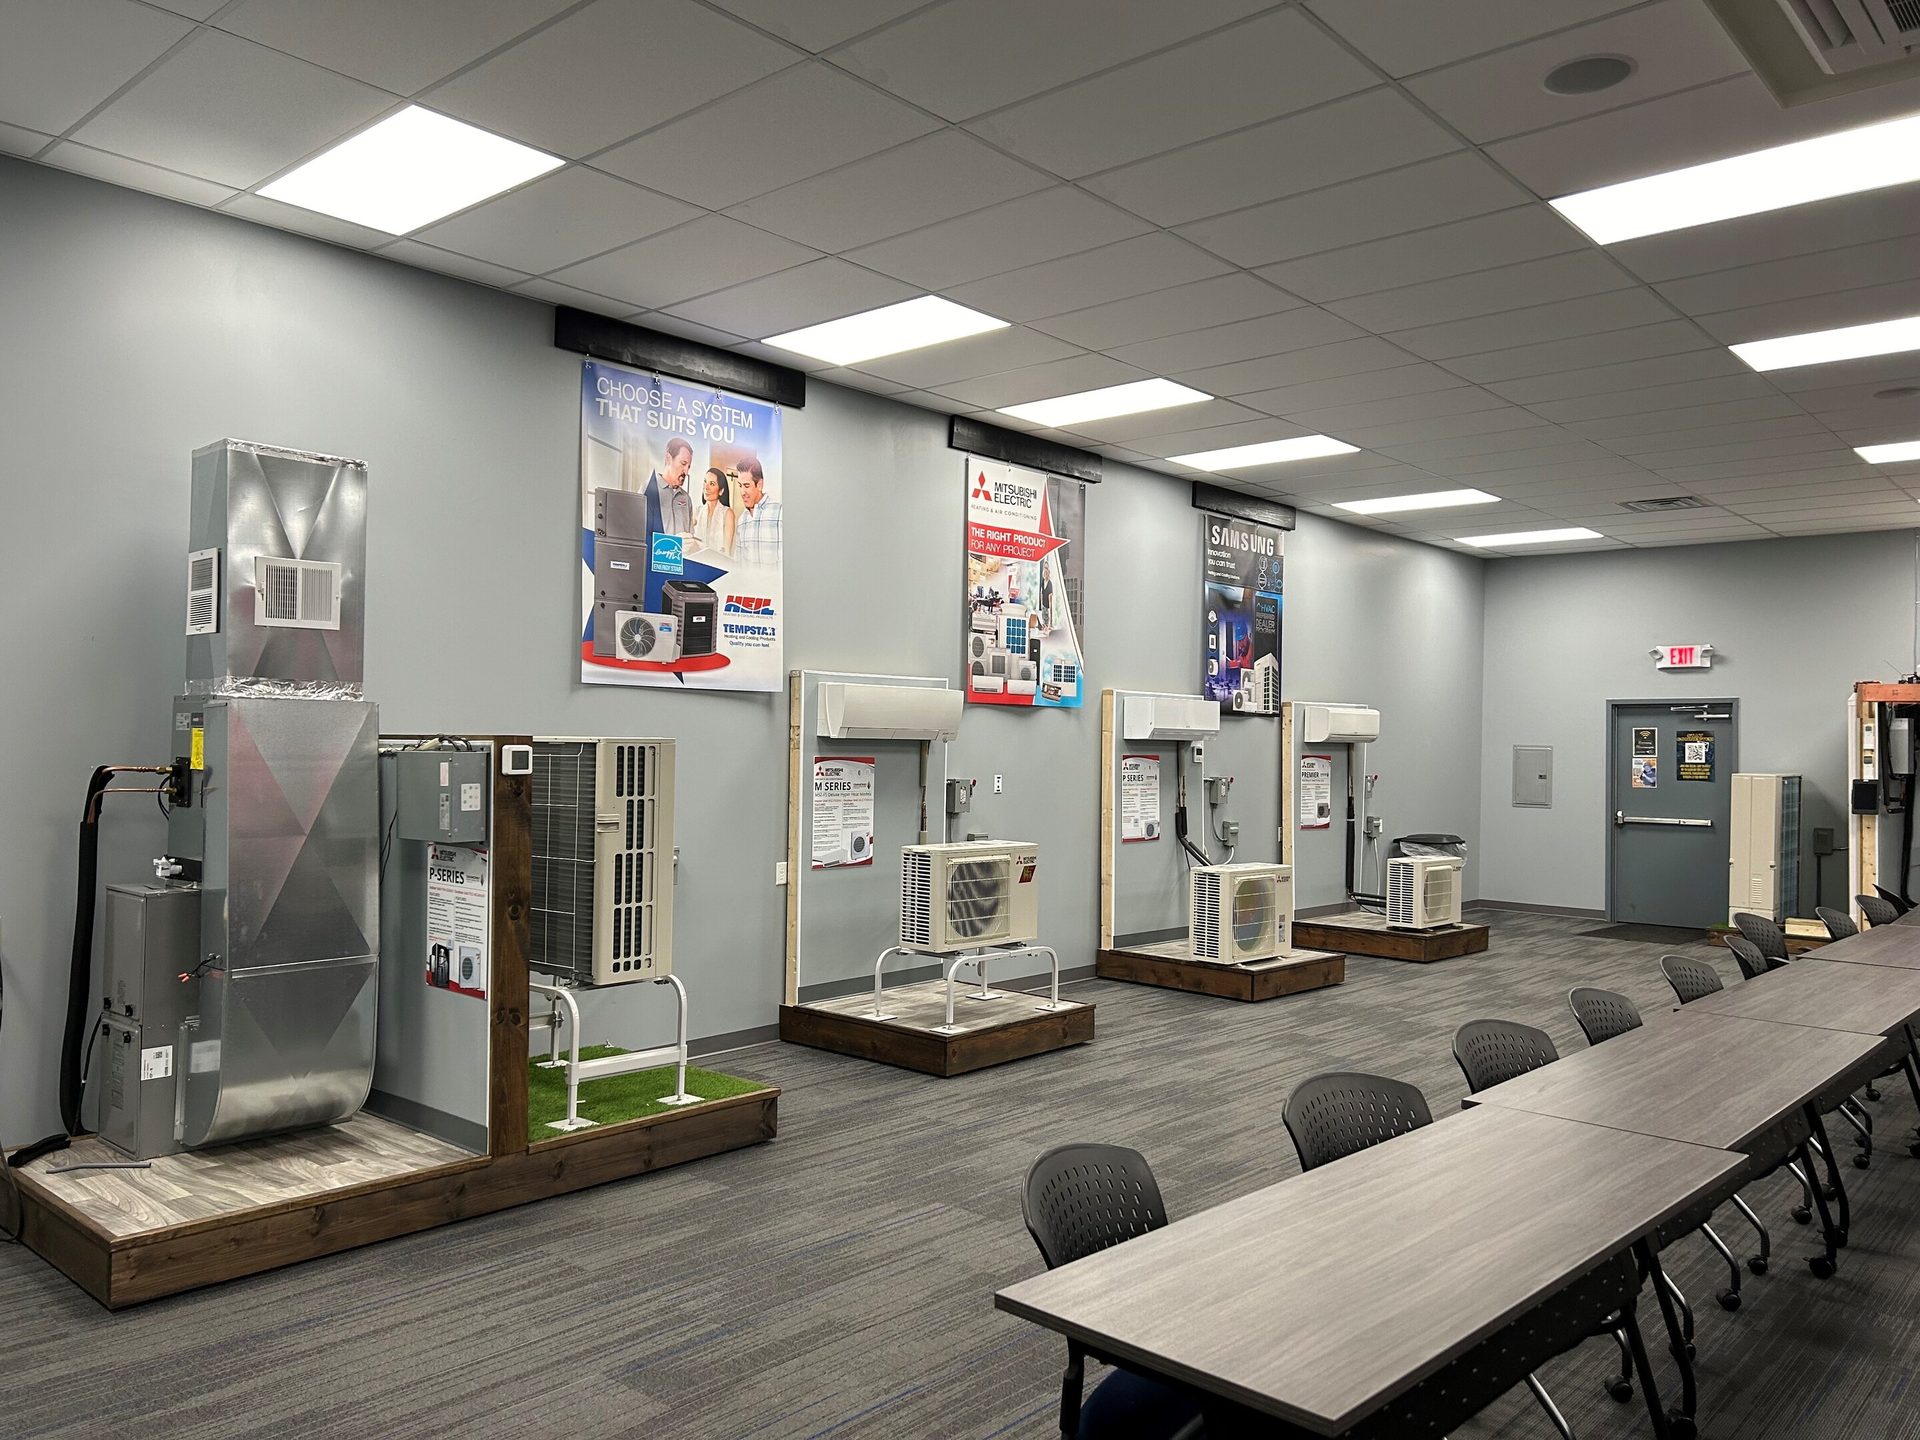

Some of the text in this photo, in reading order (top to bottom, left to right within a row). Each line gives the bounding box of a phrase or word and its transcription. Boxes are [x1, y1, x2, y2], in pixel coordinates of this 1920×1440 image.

[597, 377, 753, 430] CHOOSE A SYSTEM
[595, 398, 735, 444] THAT SUITS YOU
[994, 482, 1037, 499] MITSUBISHI
[994, 493, 1032, 509] ELECTRIC
[971, 504, 989, 513] HEATING
[1004, 510, 1037, 521] CONDITIONING
[971, 527, 1046, 548] THE RIGHT PRODUCT
[1211, 525, 1274, 556] SAMSUNG
[971, 539, 1035, 558] FOR ANY PROJECT
[653, 563, 682, 573] ENERGY STAR
[724, 595, 775, 616] HEIL
[1256, 618, 1276, 628] DEALER
[1670, 647, 1694, 665] EXIT
[815, 782, 822, 791] M
[825, 781, 851, 791] SERIES
[1123, 774, 1126, 782] P
[1127, 774, 1144, 782] SERIES
[429, 867, 464, 884] P-SERIES
